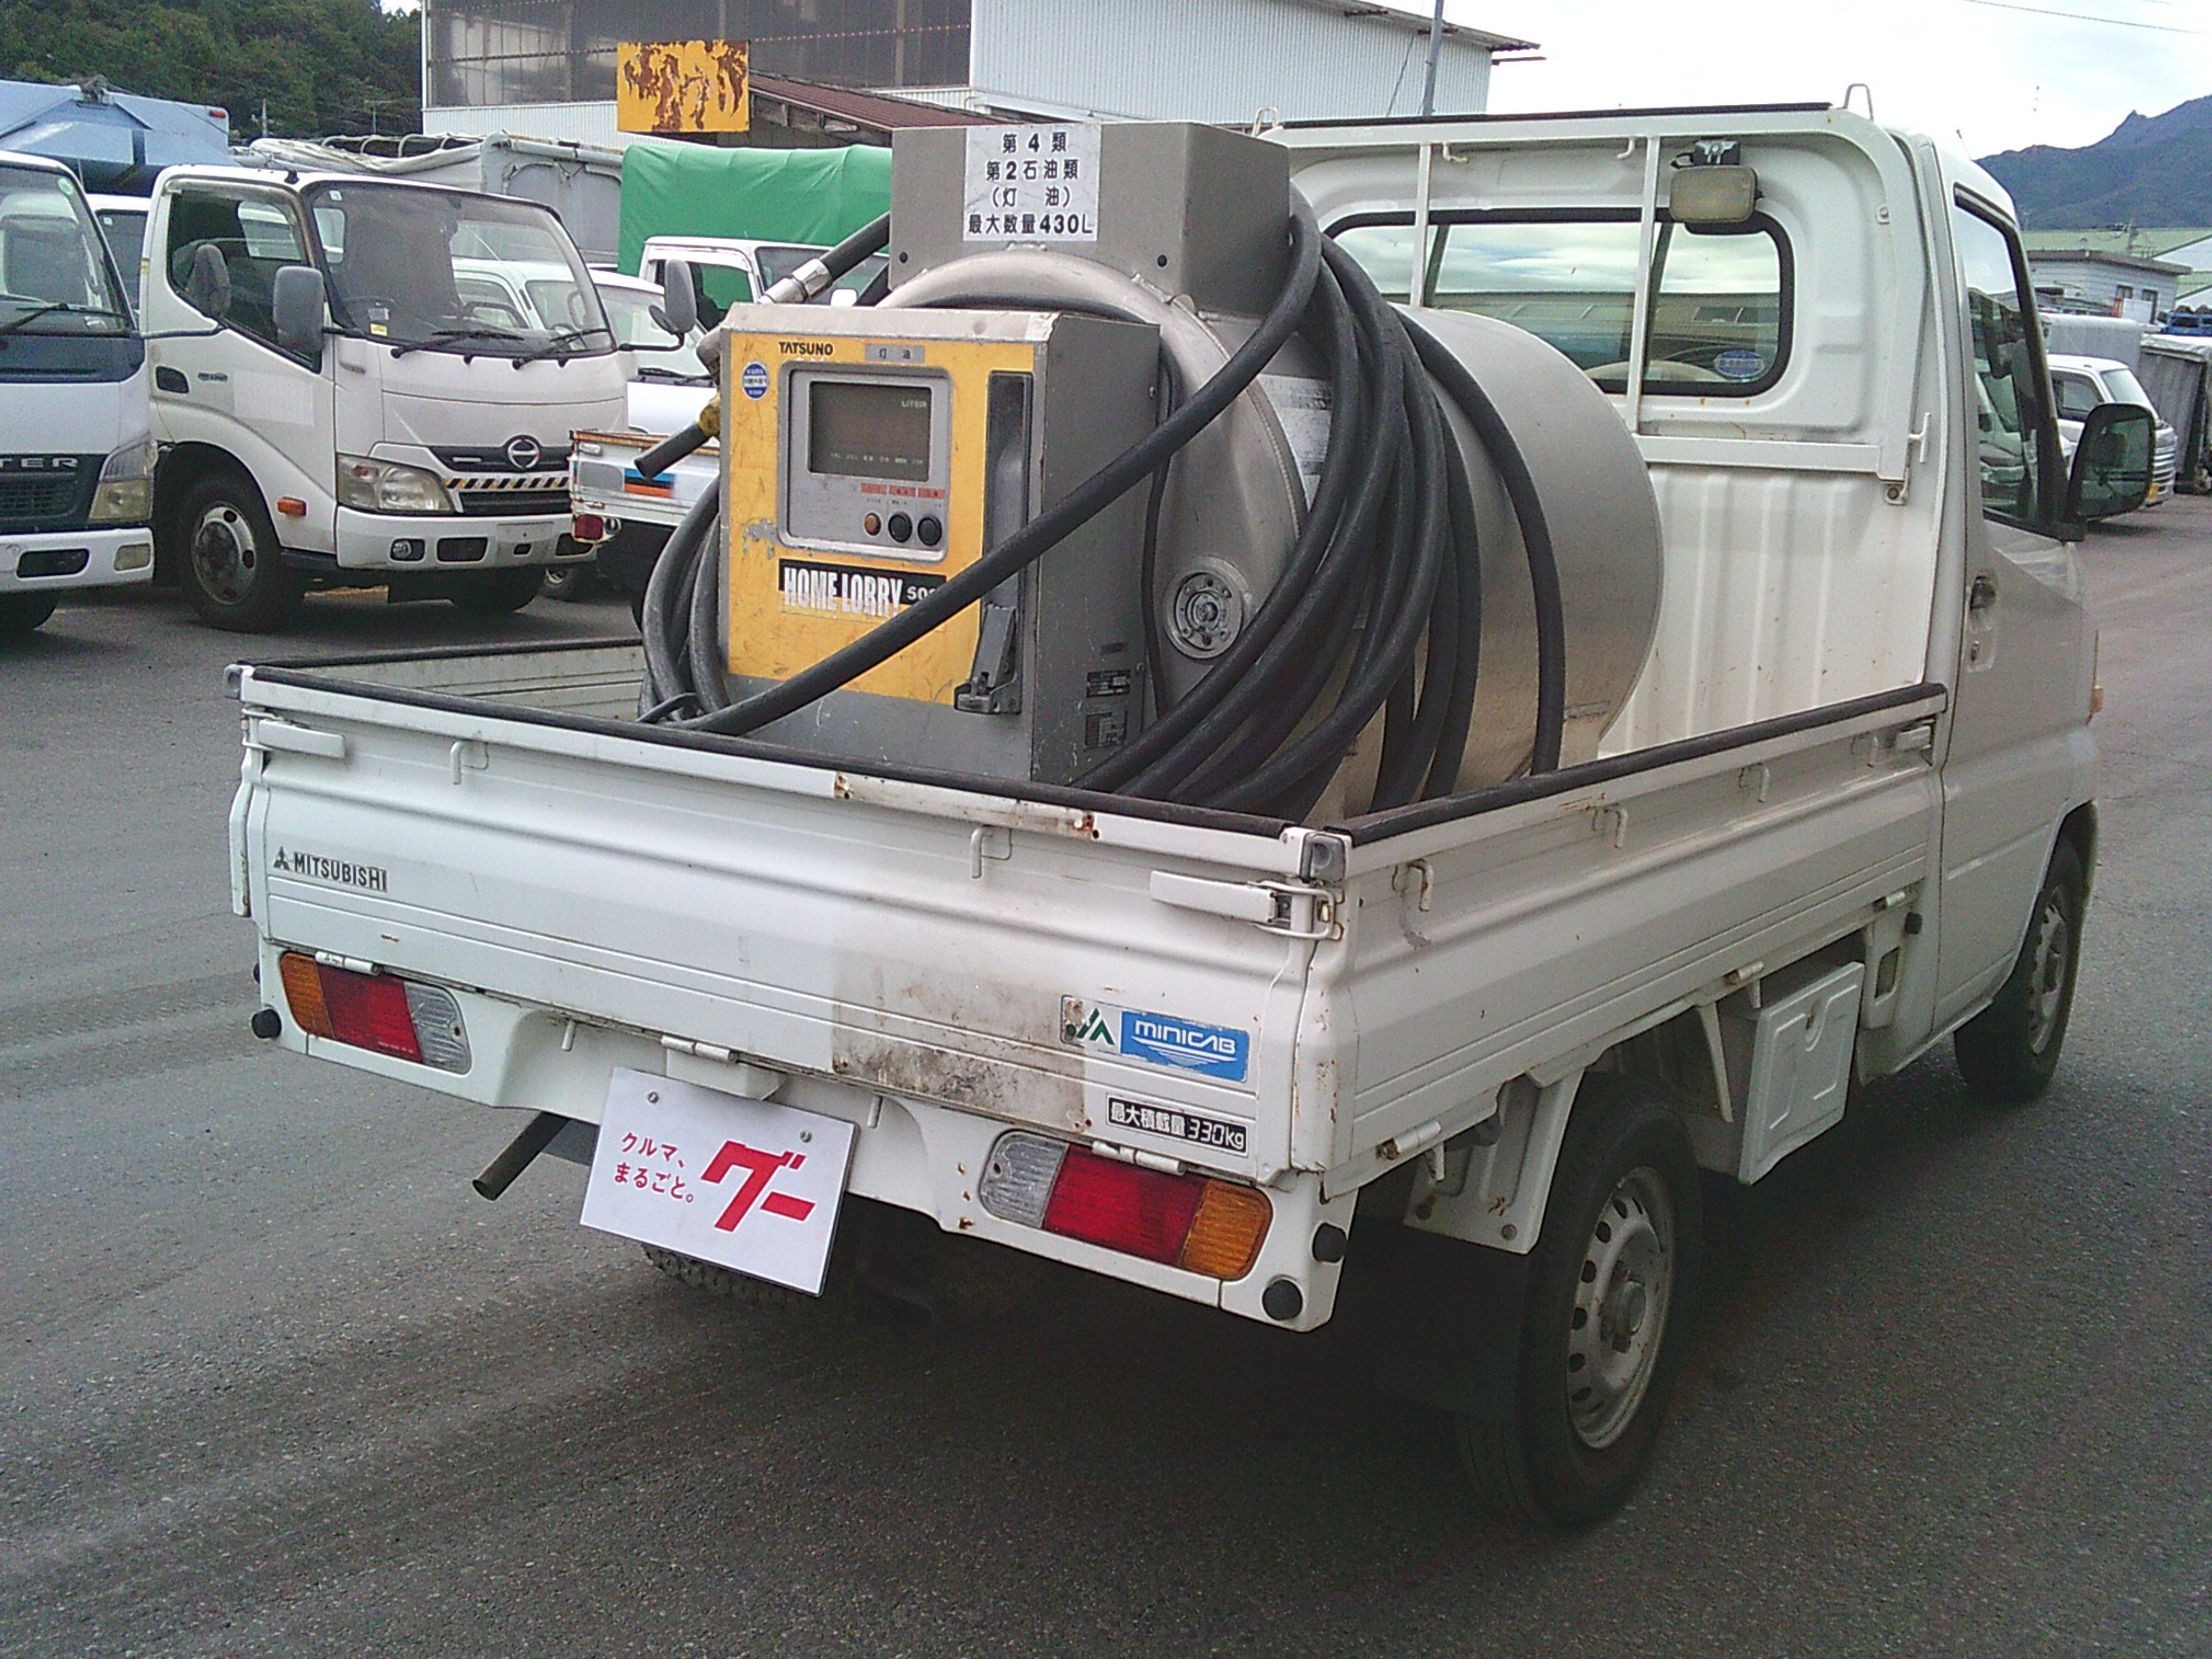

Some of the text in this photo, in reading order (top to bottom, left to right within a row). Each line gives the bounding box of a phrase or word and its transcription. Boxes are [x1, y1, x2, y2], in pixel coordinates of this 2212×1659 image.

[986, 159, 1079, 181] 第2石油類
[969, 213, 1093, 234] 最大数量430L
[778, 341, 834, 356] TATSUNO
[784, 567, 838, 611] HOME
[841, 573, 903, 618] LORRY
[294, 852, 387, 893] MITSUBISHI
[700, 1139, 817, 1233] グー
